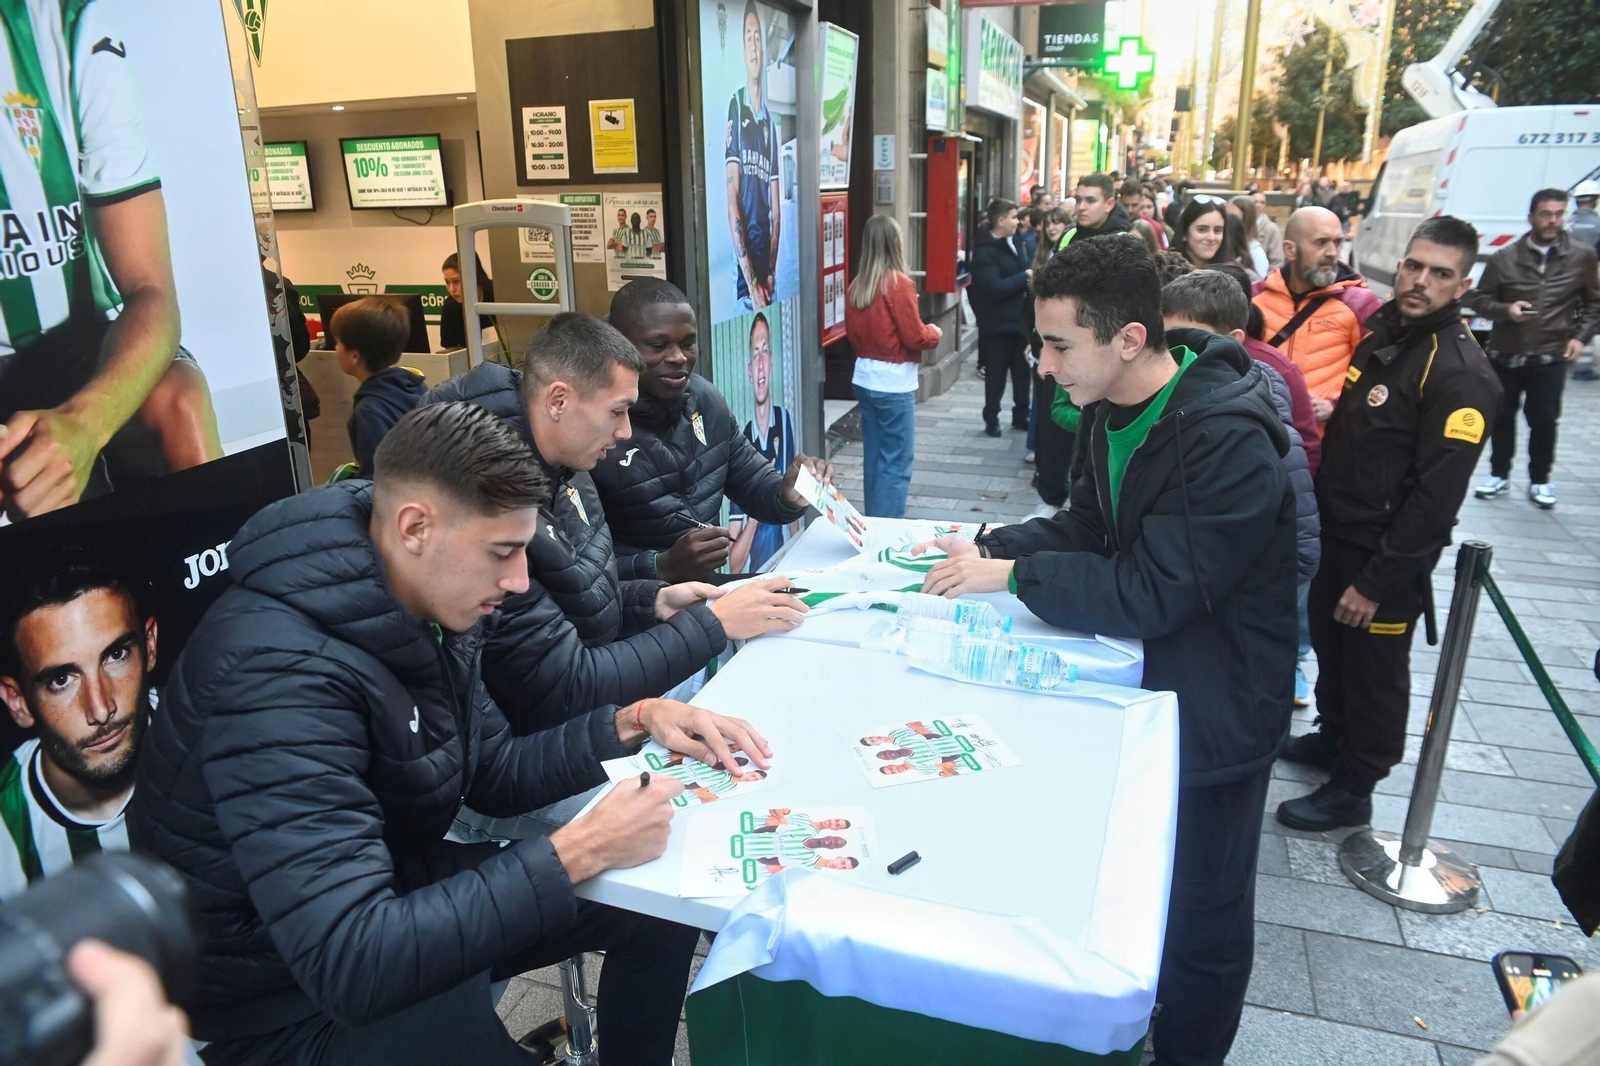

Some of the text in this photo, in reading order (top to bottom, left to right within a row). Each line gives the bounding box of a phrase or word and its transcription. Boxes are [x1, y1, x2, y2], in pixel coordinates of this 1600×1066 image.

[1044, 33, 1099, 45] TIENDAS
[981, 18, 1021, 92] FARMACIA
[1518, 133, 1550, 144] 672
[1554, 132, 1587, 144] 317
[265, 147, 292, 156] BONADOS
[356, 141, 424, 152] DESCUENTO ABONADOS
[742, 149, 770, 173] BAHRAIN
[353, 157, 389, 178] 10%
[299, 295, 314, 306] OL
[1450, 428, 1479, 439] PROSEGUR
